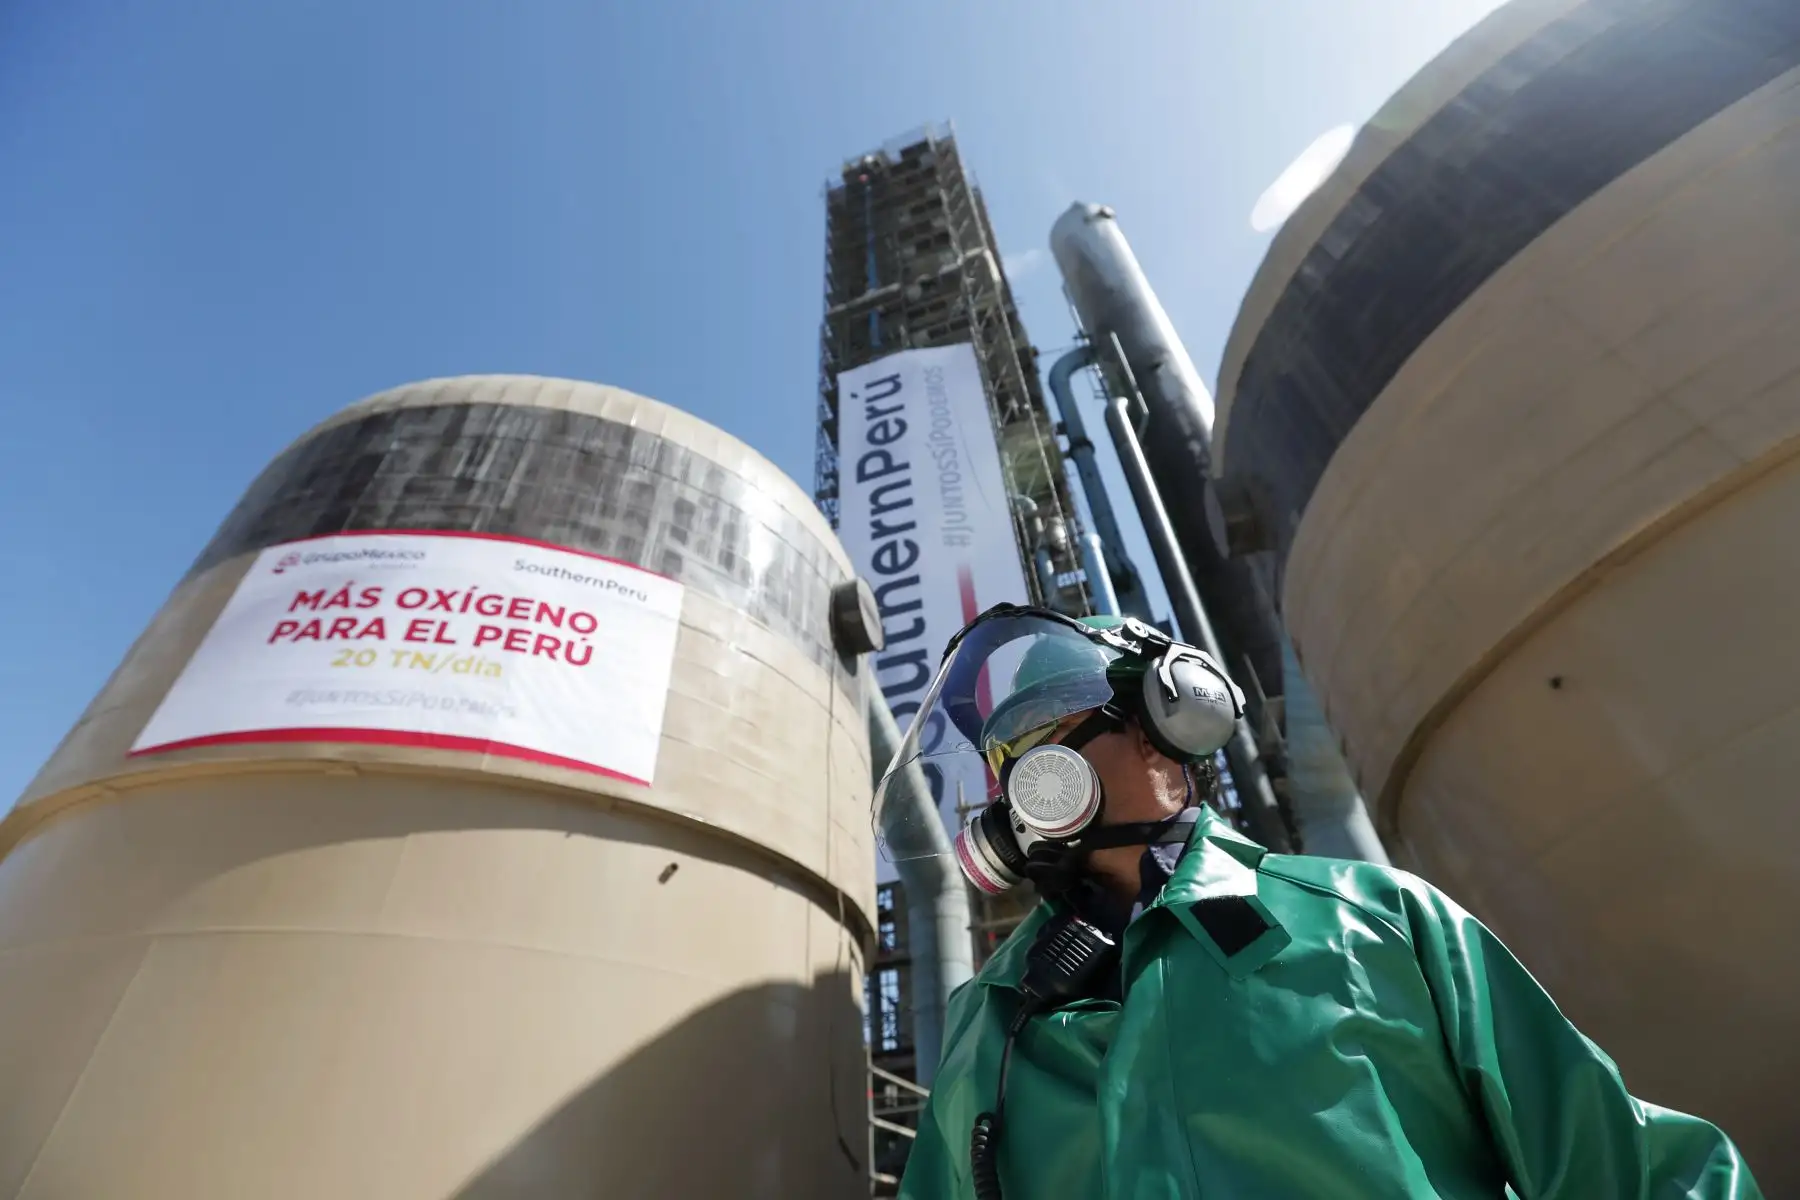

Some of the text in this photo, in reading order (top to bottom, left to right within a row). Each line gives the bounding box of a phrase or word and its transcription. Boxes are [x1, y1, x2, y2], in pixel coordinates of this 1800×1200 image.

[287, 580, 598, 634] MÁS OXÍGENO
[267, 617, 595, 666] PARA EL PERÚ
[330, 648, 377, 668] 20
[1193, 687, 1226, 703] MA
